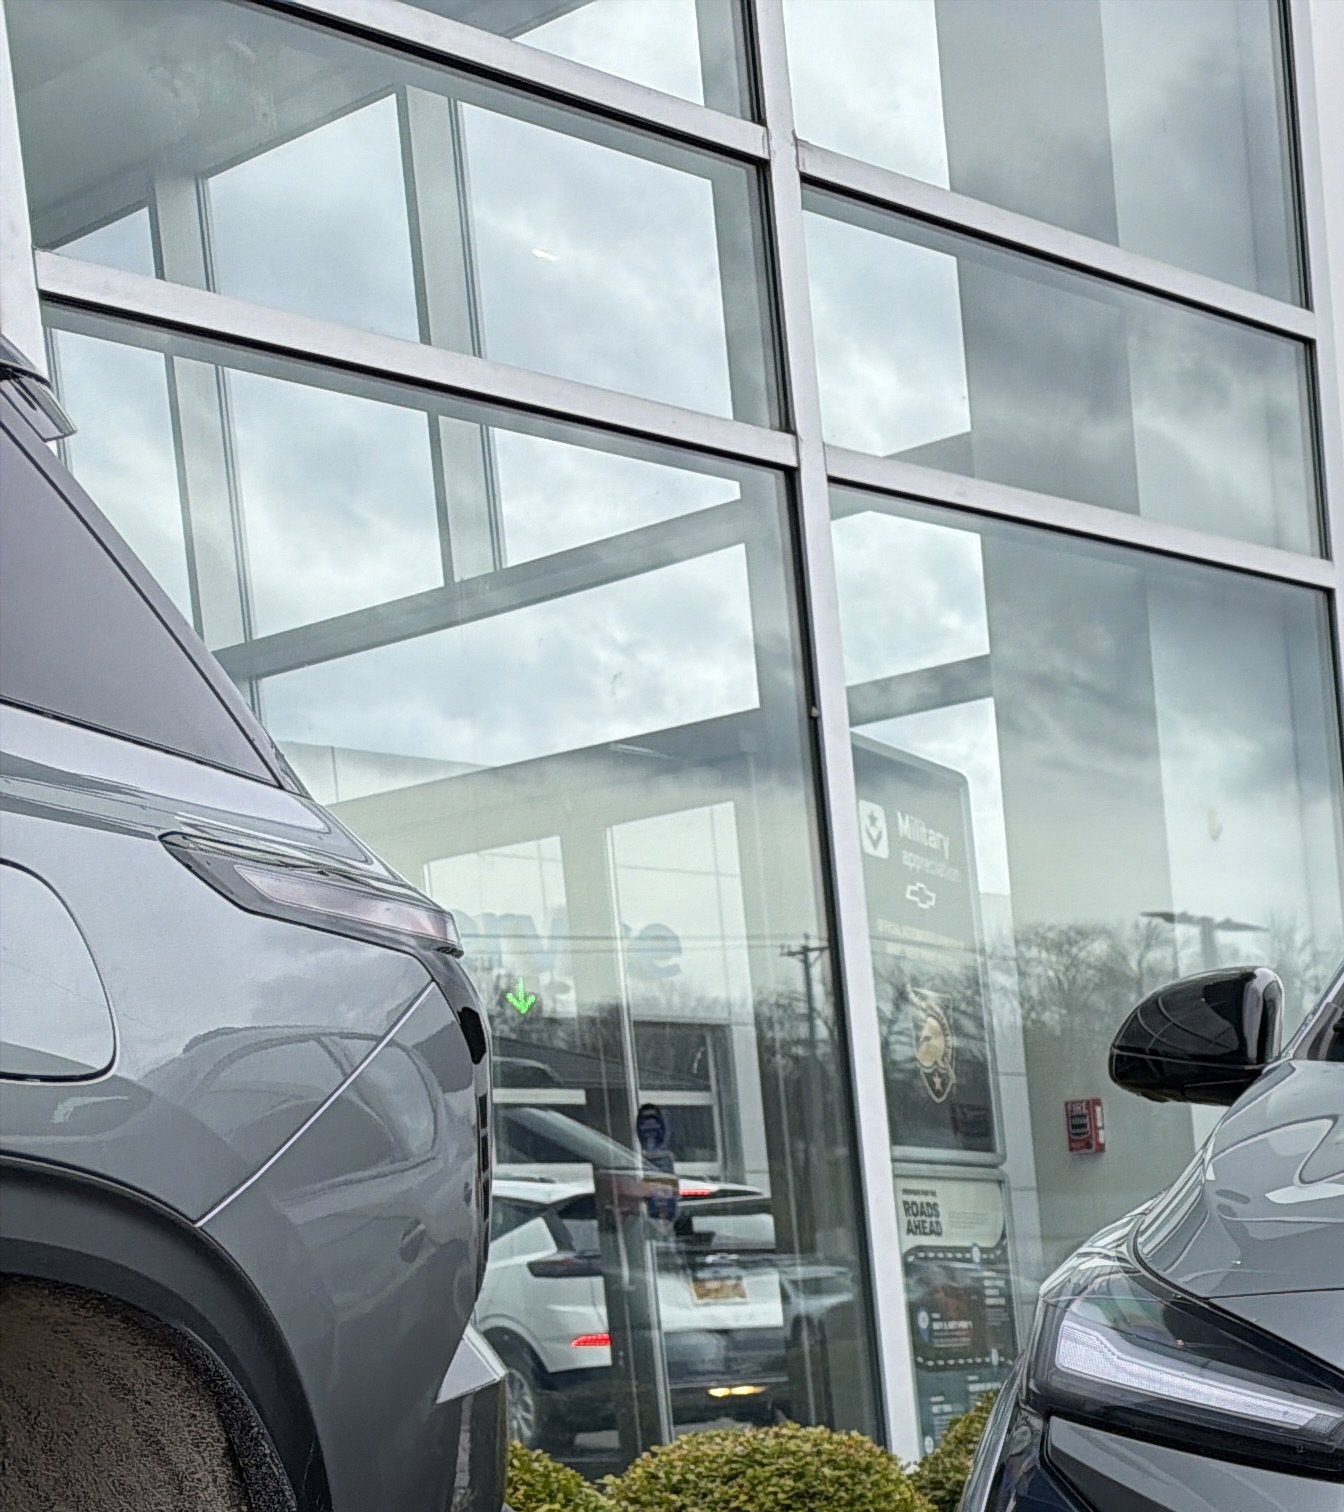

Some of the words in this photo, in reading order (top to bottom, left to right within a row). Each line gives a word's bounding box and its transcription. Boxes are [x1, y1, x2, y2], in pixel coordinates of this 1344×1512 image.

[897, 811, 950, 859] Military
[902, 1199, 940, 1219] ROADS
[905, 1218, 943, 1237] AHEAD
